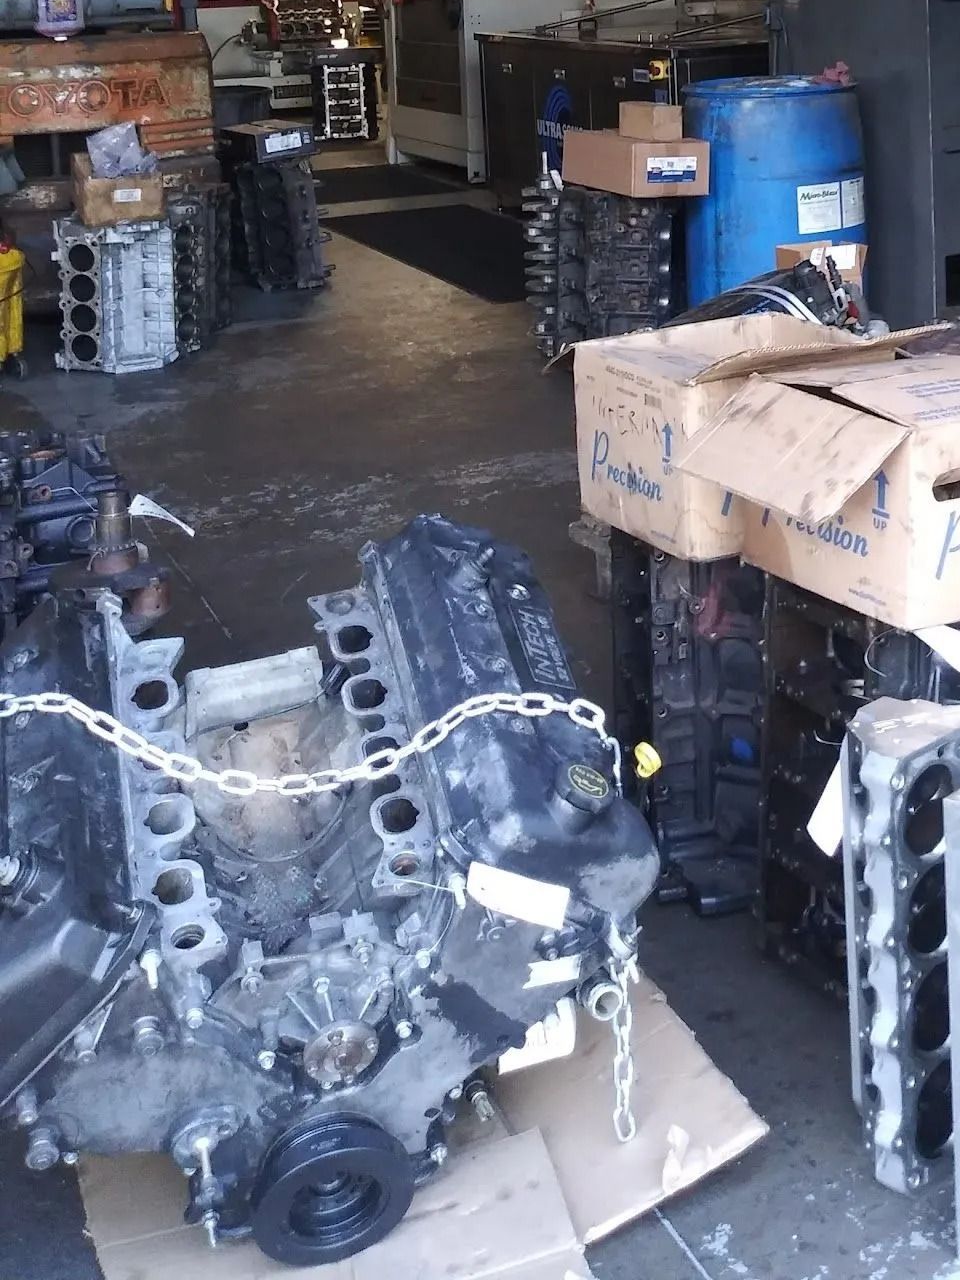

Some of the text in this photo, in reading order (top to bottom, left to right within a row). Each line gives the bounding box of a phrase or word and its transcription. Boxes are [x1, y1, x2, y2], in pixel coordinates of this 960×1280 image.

[0, 78, 171, 118] OYOTA
[536, 119, 563, 140] ULTRA
[590, 429, 663, 502] Precision
[761, 507, 869, 557] ision
[873, 517, 887, 531] UP
[518, 608, 557, 681] INTECH
